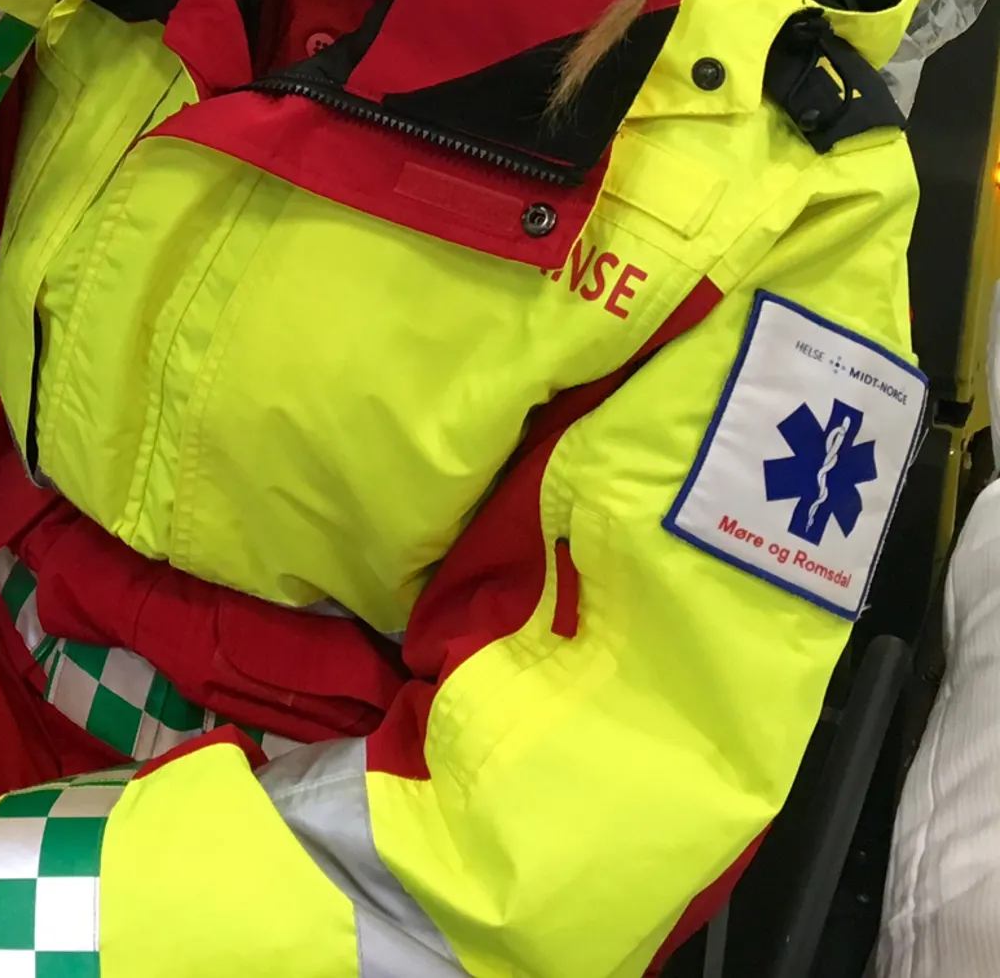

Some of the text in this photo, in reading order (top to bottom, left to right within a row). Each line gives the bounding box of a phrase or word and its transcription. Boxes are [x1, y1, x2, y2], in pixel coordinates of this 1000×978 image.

[540, 238, 648, 319] NSE
[795, 340, 908, 405] HELSE MIDT-NORGE
[718, 515, 852, 588] Møre og Romsdal
